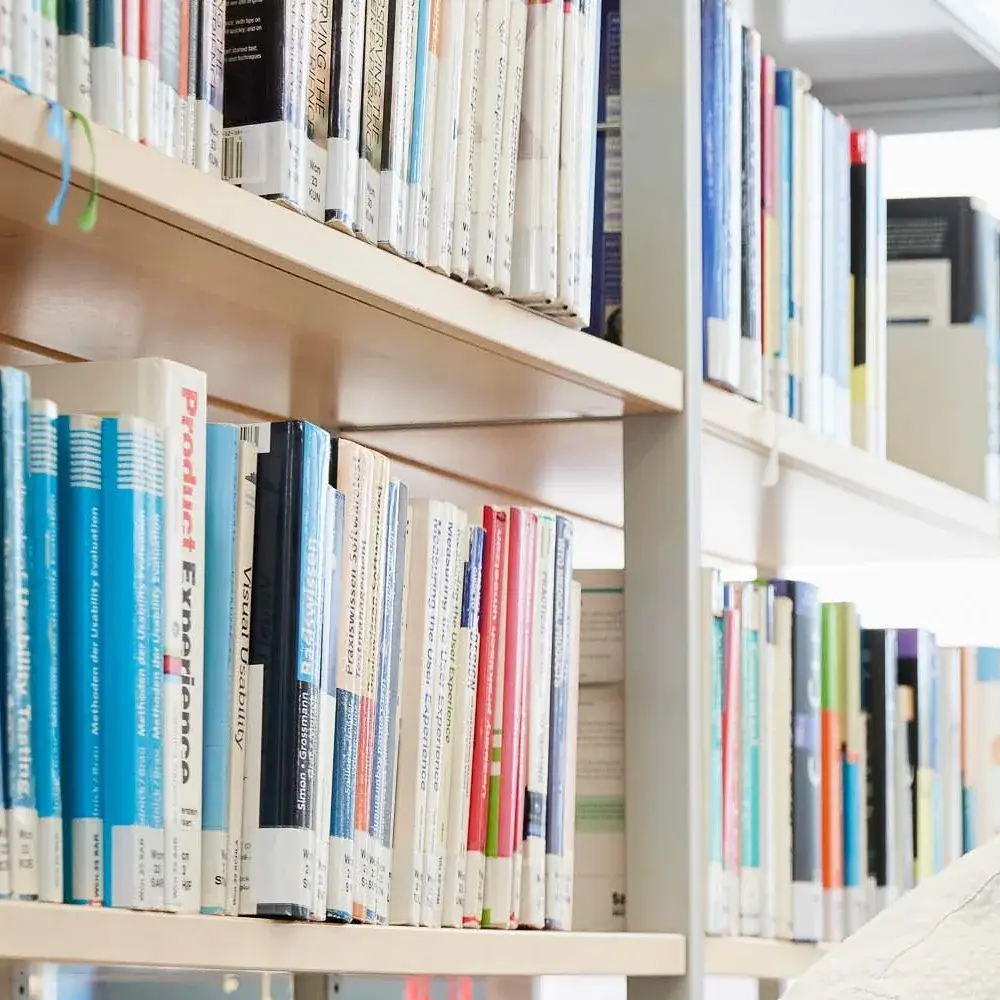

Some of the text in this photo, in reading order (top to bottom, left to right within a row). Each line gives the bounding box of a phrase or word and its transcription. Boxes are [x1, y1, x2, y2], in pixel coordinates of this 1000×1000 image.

[312, 76, 326, 118] THE
[370, 104, 383, 146] THE
[90, 506, 99, 578] Evaluation
[427, 518, 442, 610] Measuring
[440, 521, 454, 611] Measuring
[90, 580, 99, 639] Usability
[137, 584, 146, 641] Usability
[153, 587, 163, 644] Usability
[180, 386, 198, 785] Product Experience
[301, 537, 319, 675] Basiswissen
[345, 563, 358, 676] Praxiswissen
[484, 624, 498, 716] praktisch
[493, 528, 504, 621] umsetzen
[552, 537, 566, 690] INTO MEDICAL PRODUCTS
[16, 586, 31, 697] Usability
[91, 641, 99, 664] der
[137, 643, 146, 666] der
[153, 645, 163, 667] der
[233, 567, 253, 751] Visual Usability
[425, 648, 435, 686] User
[438, 649, 447, 687] User
[450, 631, 459, 663] User
[91, 666, 100, 737] Methoden
[137, 668, 147, 738] Methoden
[152, 667, 163, 740] Methoden
[446, 666, 457, 744] Experience
[16, 704, 33, 799] Testing
[297, 690, 311, 811] Simon Grossmann
[419, 691, 432, 793] Experience
[433, 694, 445, 793] Experience
